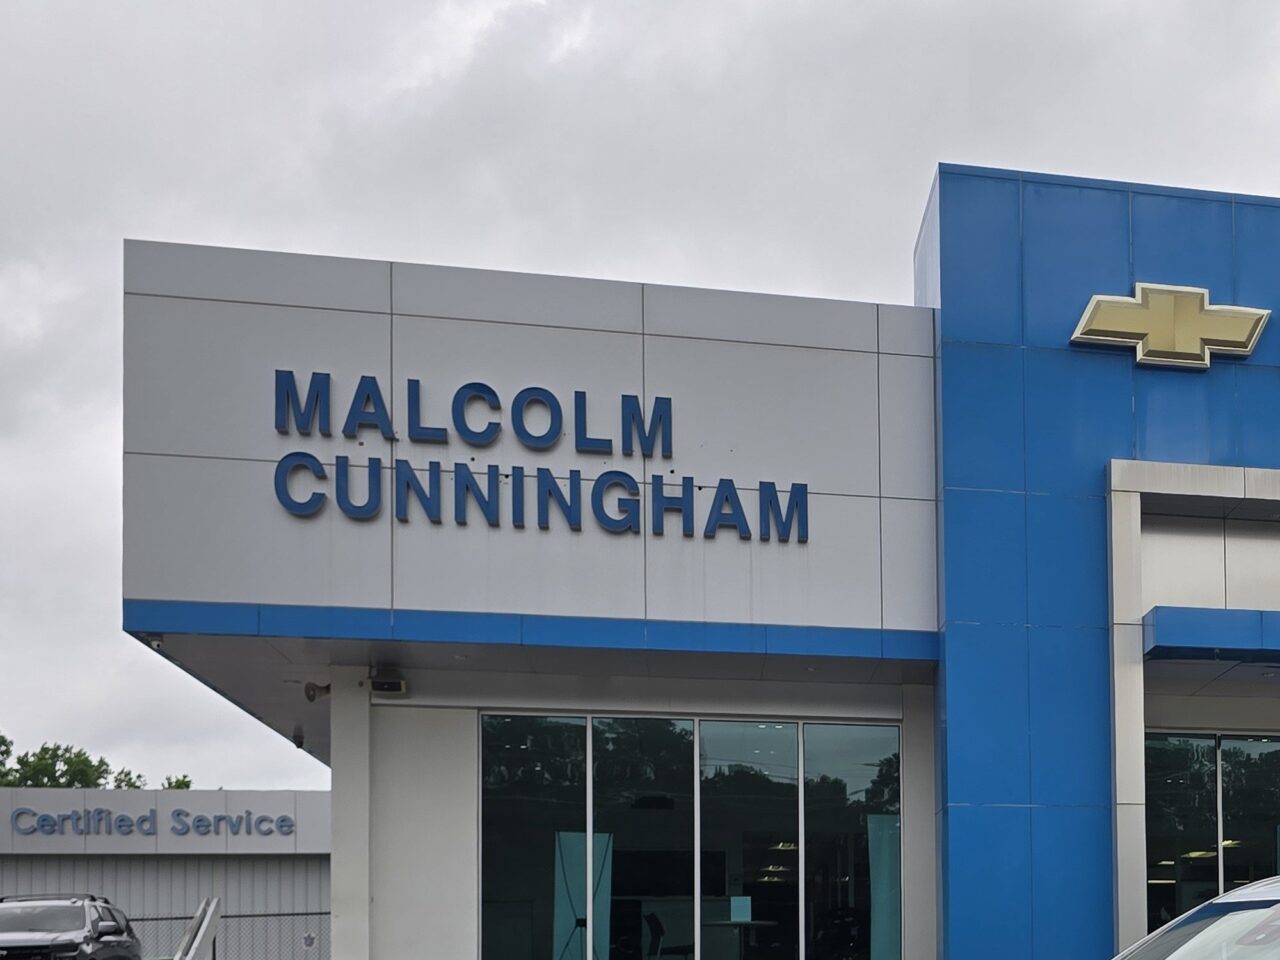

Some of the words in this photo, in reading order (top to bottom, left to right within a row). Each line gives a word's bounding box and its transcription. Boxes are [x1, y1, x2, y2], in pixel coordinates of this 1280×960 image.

[275, 369, 673, 459] MALCOLM
[274, 451, 808, 543] CUNNINGHAM
[11, 807, 158, 836] Certified
[170, 808, 295, 836] Service
